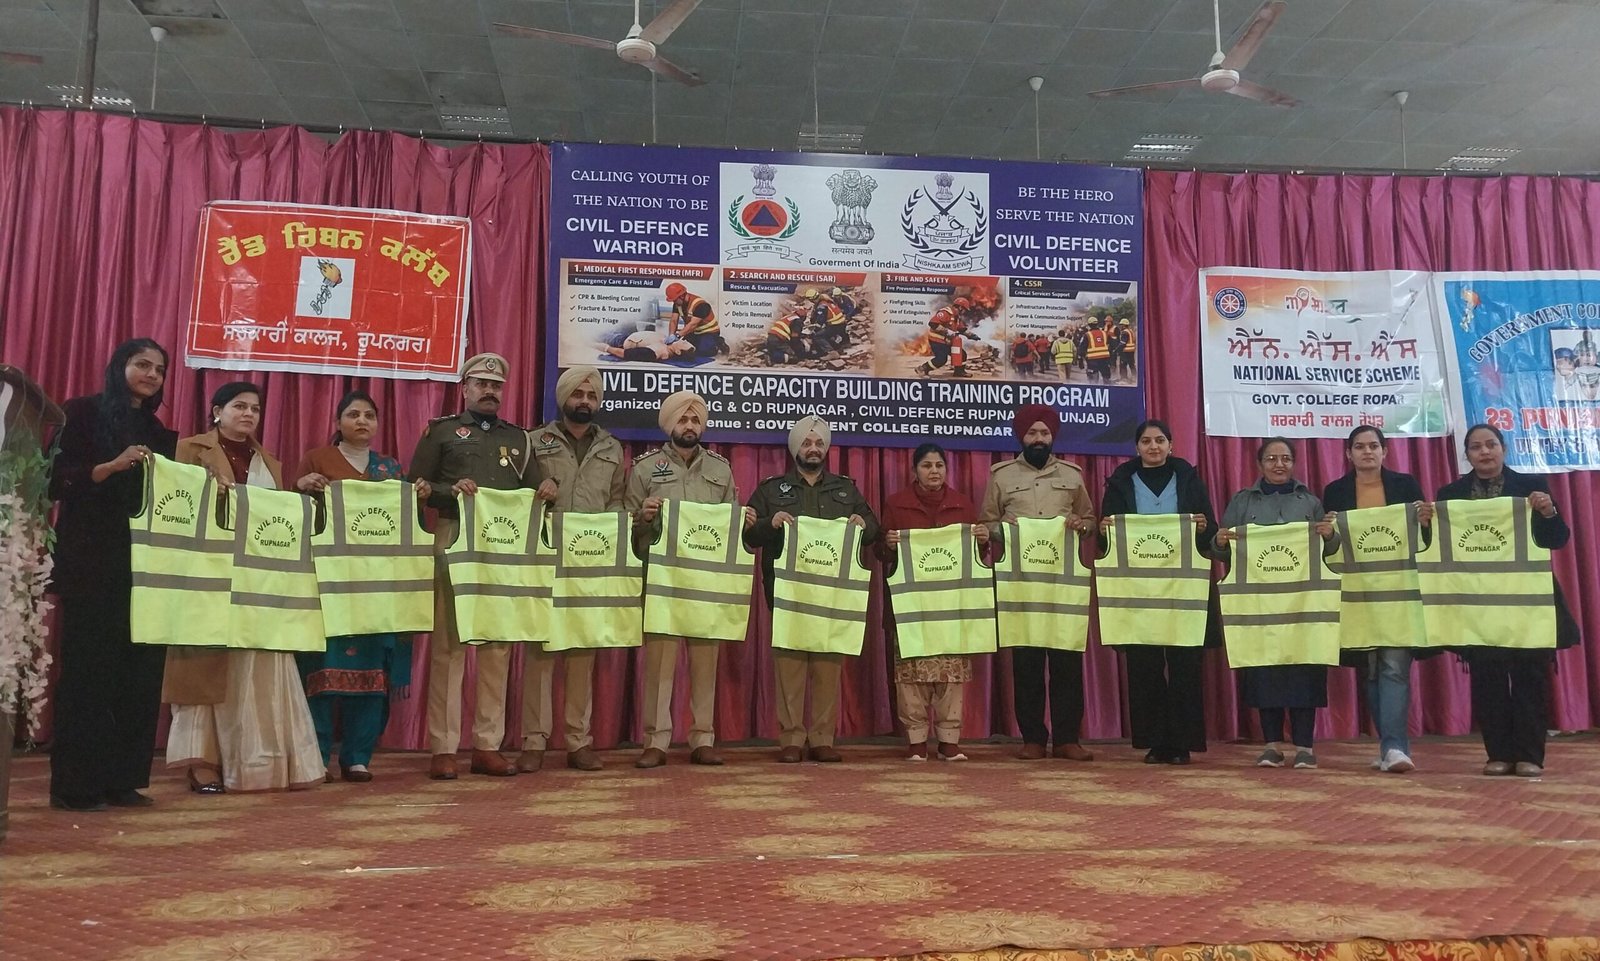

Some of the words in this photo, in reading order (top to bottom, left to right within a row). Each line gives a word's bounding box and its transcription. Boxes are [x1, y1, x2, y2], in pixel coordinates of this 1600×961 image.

[571, 169, 634, 184] CALLING
[638, 172, 687, 186] YOUTH
[692, 174, 710, 186] OF
[573, 194, 602, 206] THE
[607, 196, 662, 209] NATION
[667, 198, 687, 210] TO
[690, 200, 708, 210] BE
[1018, 186, 1036, 198] BE
[1040, 188, 1070, 200] THE
[1074, 190, 1114, 202] HERO
[996, 208, 1041, 221] SERVE
[1044, 210, 1074, 222] THE
[1078, 212, 1135, 226] NATION
[566, 217, 614, 232] CIVIL
[620, 219, 708, 236] DEFENCE
[593, 238, 684, 256] WARRIOR
[994, 234, 1040, 249] CIVIL
[1046, 236, 1132, 254] DEFENCE
[281, 221, 366, 250] ਰਿਬਨ
[380, 236, 450, 288] ਕਲੱਬ
[809, 258, 860, 268] Goverment
[863, 259, 875, 268] Of
[876, 260, 900, 269] India
[584, 266, 616, 274] MEDICAL
[618, 266, 638, 274] FIRST
[640, 268, 681, 276] RESPONDER
[682, 268, 704, 278] (MFR)
[917, 259, 951, 269] NISHKAAM
[952, 260, 972, 269] SEWA
[1008, 255, 1119, 274] VOLUNTEER
[574, 278, 606, 286] Emergency
[730, 270, 738, 278] 2.
[740, 272, 768, 280] SEARCH
[770, 272, 786, 280] AND
[788, 274, 814, 282] RESCUE
[816, 274, 836, 283] (SAR)
[886, 274, 893, 282] 3.
[924, 276, 950, 284] SAFETY
[1024, 280, 1043, 288] CSSR
[758, 284, 788, 292] Evacuation
[596, 294, 620, 302] Bleeding
[577, 316, 600, 324] Casualty
[223, 320, 288, 343] ਸਰਕਾਰੀ
[294, 328, 348, 350] ਕਾਲਜ,
[1468, 304, 1574, 362] GOVERNMENT
[1233, 364, 1301, 381] NATIONAL
[1305, 366, 1362, 384] SERVICE
[1366, 365, 1420, 383] SCHEME
[602, 371, 638, 392] IVIL
[644, 373, 734, 396] DEFENCE
[740, 376, 830, 399] CAPACITY
[836, 380, 924, 402] BUILDING
[928, 382, 1014, 404] TRAINING
[1020, 385, 1110, 408] PROGRAM
[1252, 394, 1292, 405] GOVT.
[1296, 394, 1358, 405] COLLEGE
[1363, 394, 1405, 405] ROPAR
[600, 398, 661, 412] rganized
[727, 401, 737, 412] &
[742, 402, 762, 413] CD
[766, 402, 847, 416] RUPNAGAR
[859, 405, 894, 418] CIVIL
[898, 406, 964, 420] DEFENCE
[968, 409, 1016, 420] RUPNA
[1060, 412, 1110, 426] UNJAB)
[1270, 412, 1314, 427] ਸਰਕਾਰੀ
[1320, 414, 1354, 427] ਕਾਲਜ
[1485, 408, 1514, 430] 23
[706, 420, 742, 428] enue
[755, 420, 858, 432] GOVEENT
[862, 422, 930, 434] COLLEGE
[934, 424, 1012, 436] RUPNAGAR
[154, 492, 174, 516] CIVIL
[175, 489, 195, 520] DEFENCE
[162, 514, 190, 525] RUPNAGAR
[351, 512, 366, 532] CIVIL
[368, 507, 396, 532] DEFENCE
[482, 520, 492, 538] CIVIL
[494, 516, 520, 540] DEFENCE
[254, 520, 270, 540] CIVIL
[272, 516, 296, 543] DEFENCE
[683, 527, 696, 544] CIVIL
[698, 524, 722, 548] DEFENCE
[1356, 530, 1370, 550] CIVIL
[1370, 526, 1402, 546] DEFENCE
[1458, 528, 1474, 548] CIVIL
[1474, 524, 1508, 546] DEFENCE
[260, 539, 290, 548] RUPNAGAR
[486, 536, 514, 544] RUPNAGAR
[568, 533, 582, 552] CIVIL
[584, 530, 610, 550] DEFENCE
[688, 543, 716, 552] RUPNAGAR
[1132, 538, 1146, 555] CIVIL
[1146, 534, 1174, 554] DEFENCE
[800, 542, 814, 559] CIVIL
[815, 540, 838, 562] DEFENCE
[918, 551, 930, 568] CIVIL
[931, 548, 958, 566] DEFENCE
[1022, 543, 1036, 560] CIVIL
[1036, 540, 1060, 561] DEFENCE
[1256, 550, 1270, 568] CIVIL
[1270, 544, 1300, 568] DEFENCE
[804, 558, 832, 566] RUPNAGAR
[1028, 558, 1055, 566] RUPNAGAR
